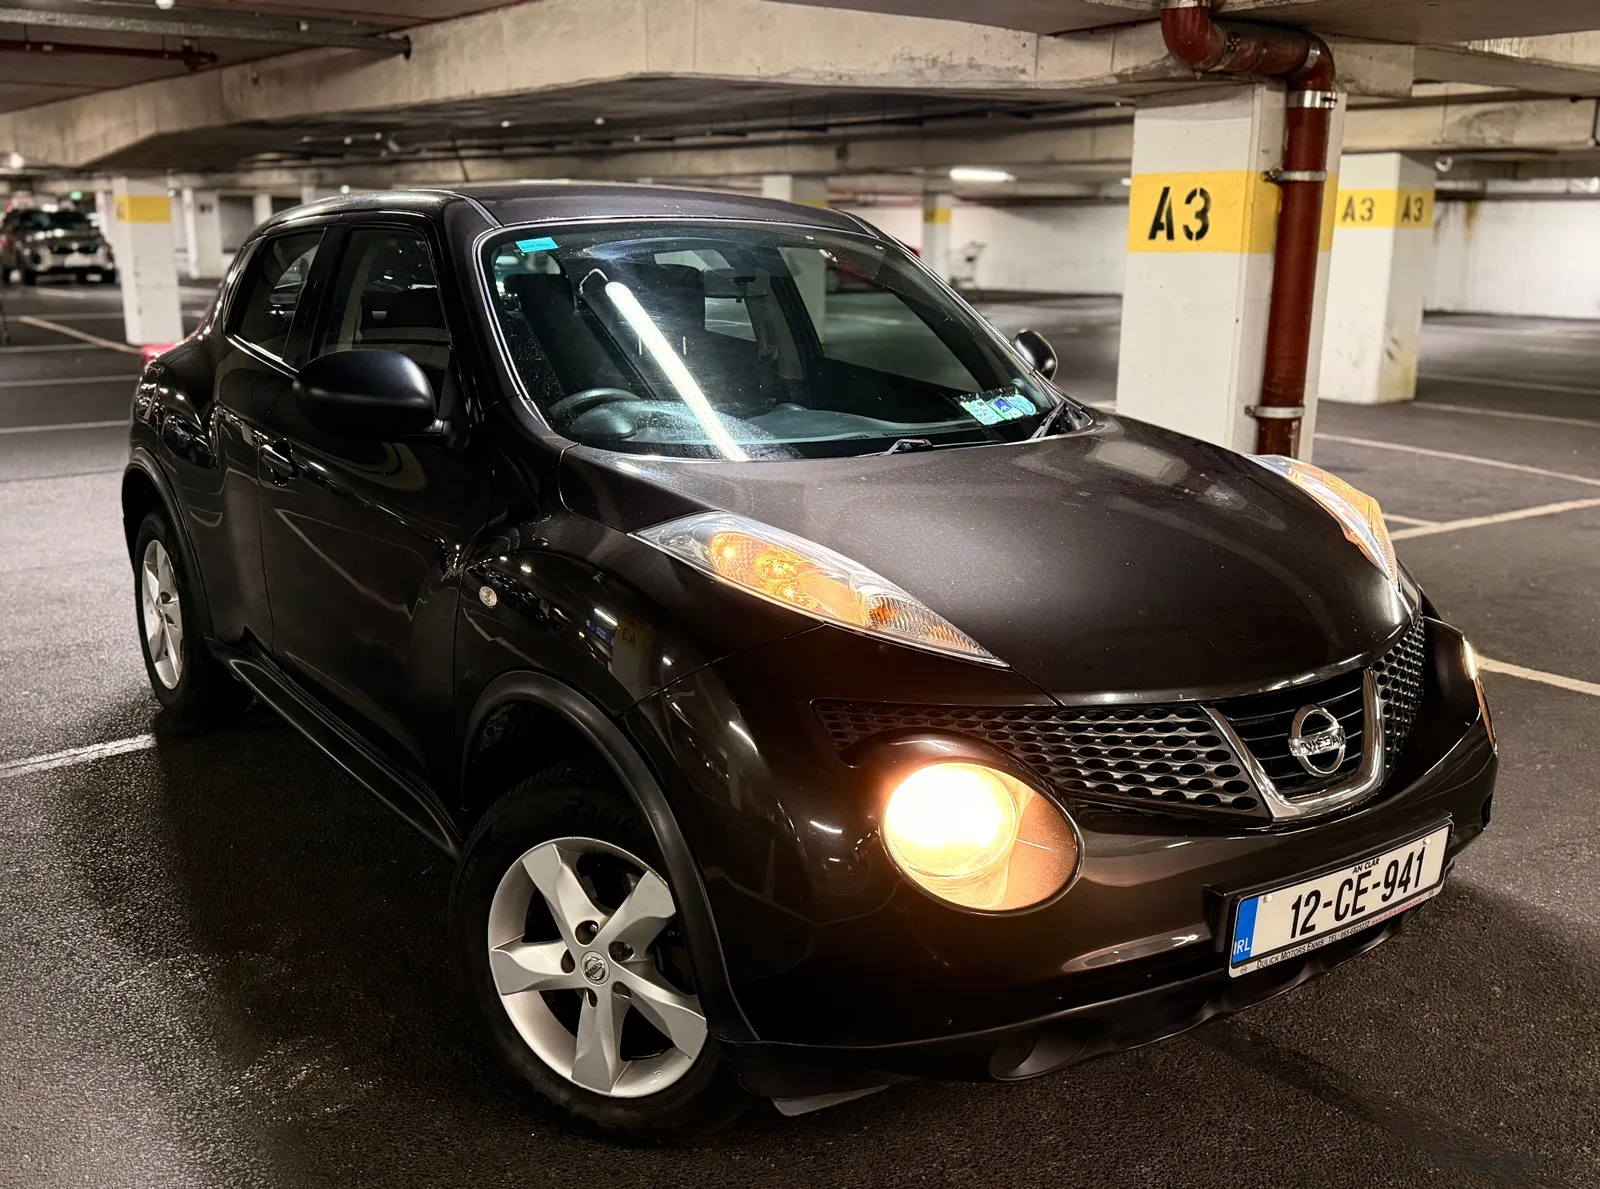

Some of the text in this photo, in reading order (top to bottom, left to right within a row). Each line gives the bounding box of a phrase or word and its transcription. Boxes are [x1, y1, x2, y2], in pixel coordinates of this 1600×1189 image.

[1148, 187, 1211, 241] A3
[1342, 195, 1376, 222] A3
[1400, 196, 1425, 222] A3
[1352, 865, 1363, 874] AN
[1289, 846, 1426, 939] 12-CE-941
[1233, 937, 1251, 956] IRL
